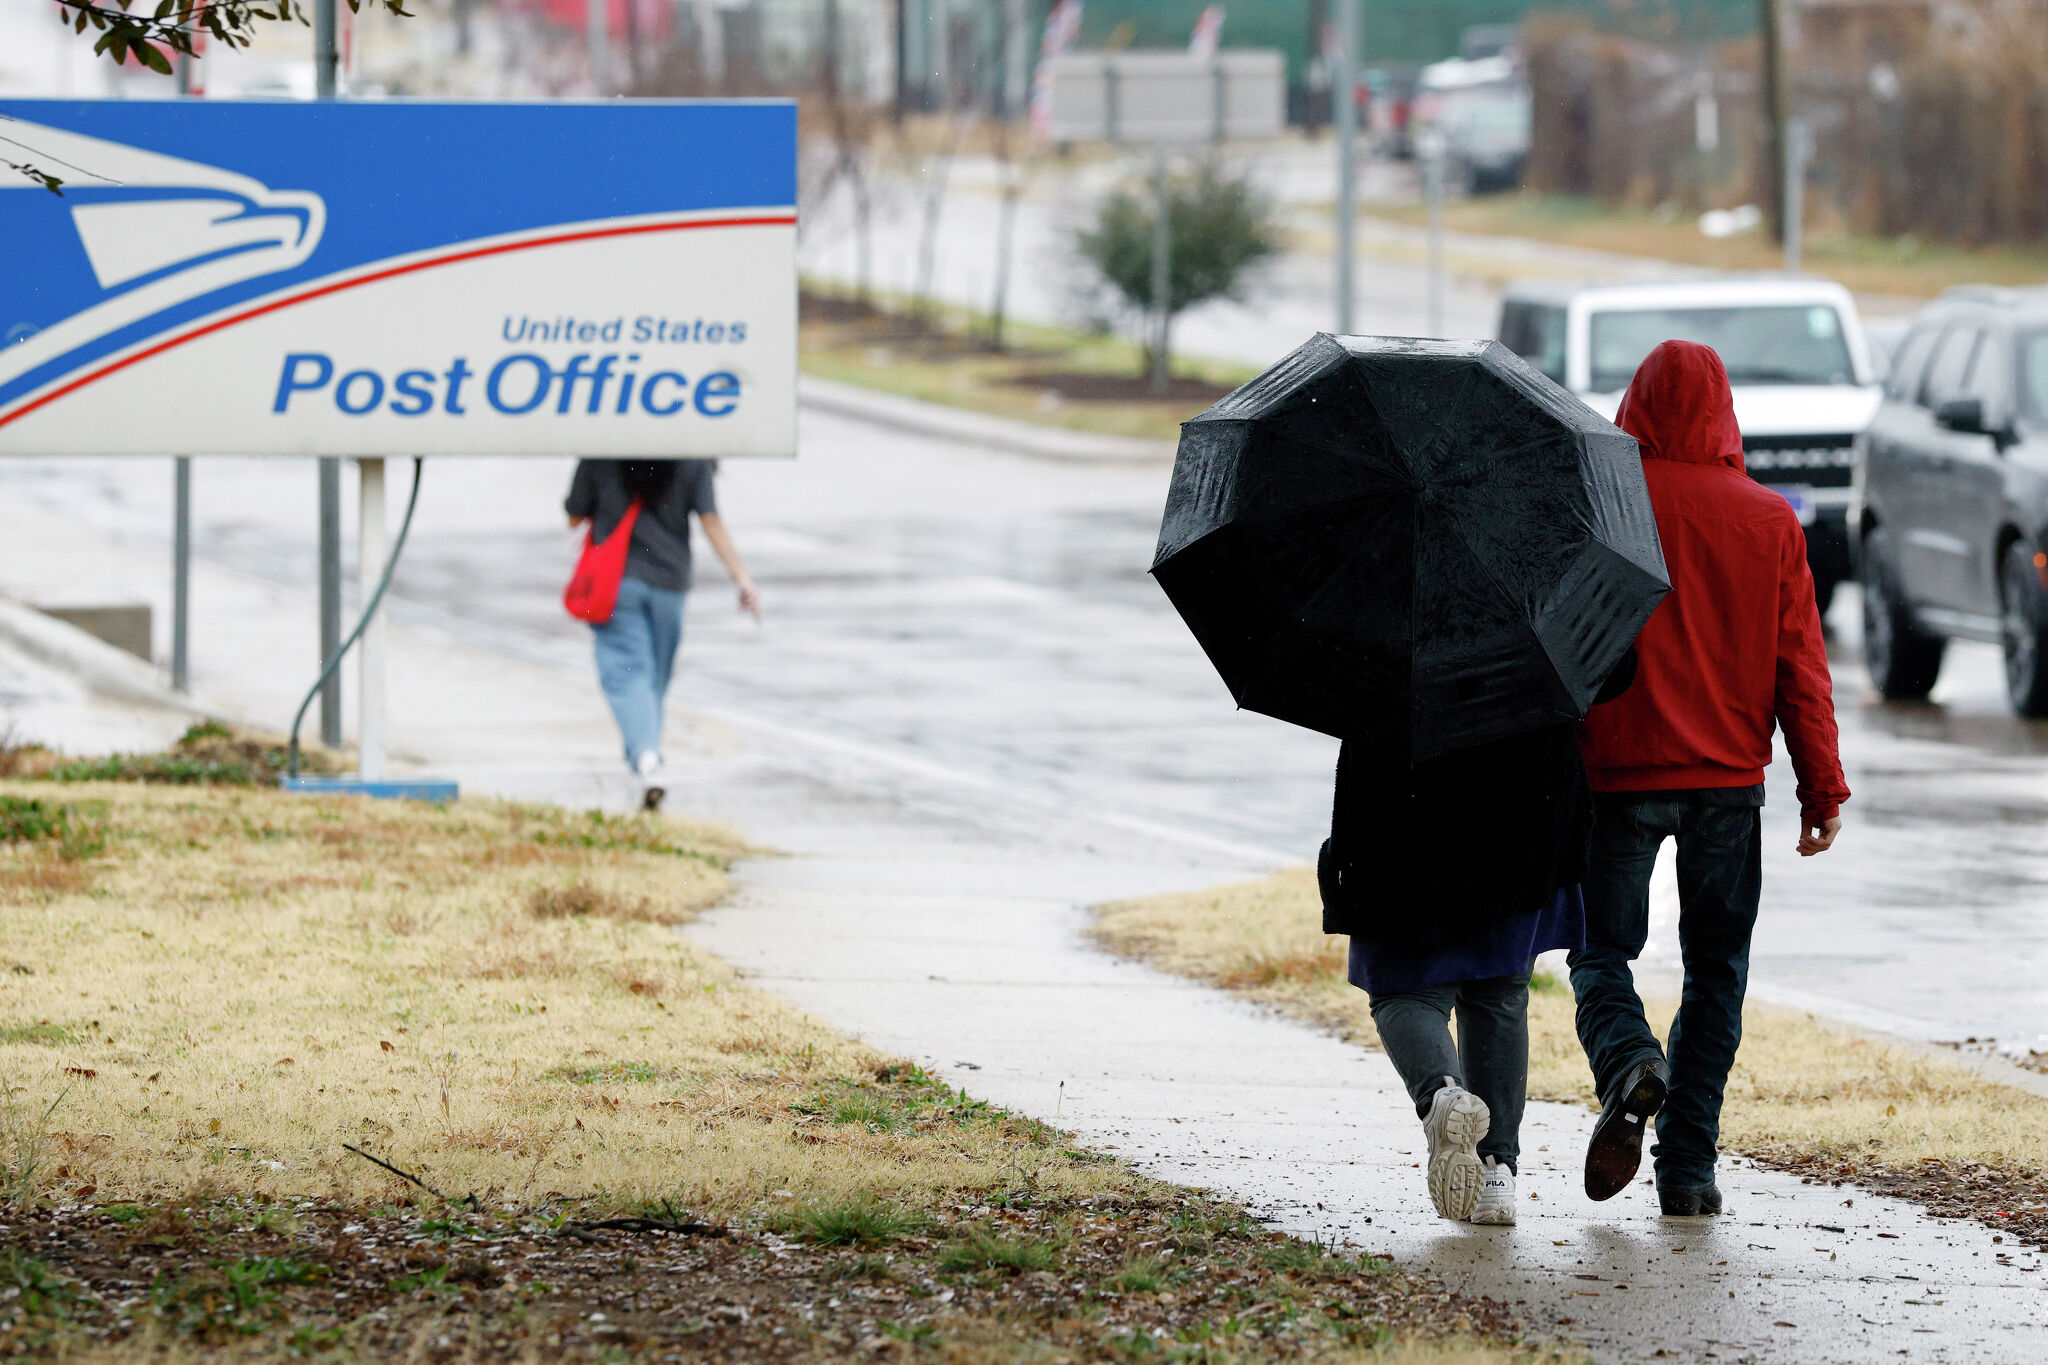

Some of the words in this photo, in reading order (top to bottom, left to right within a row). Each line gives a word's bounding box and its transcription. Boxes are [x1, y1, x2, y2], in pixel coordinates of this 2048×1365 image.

[502, 315, 623, 344] United
[632, 315, 748, 344] States
[272, 352, 474, 417] Post
[484, 352, 742, 417] Office
[1485, 1180, 1505, 1188] FILA
